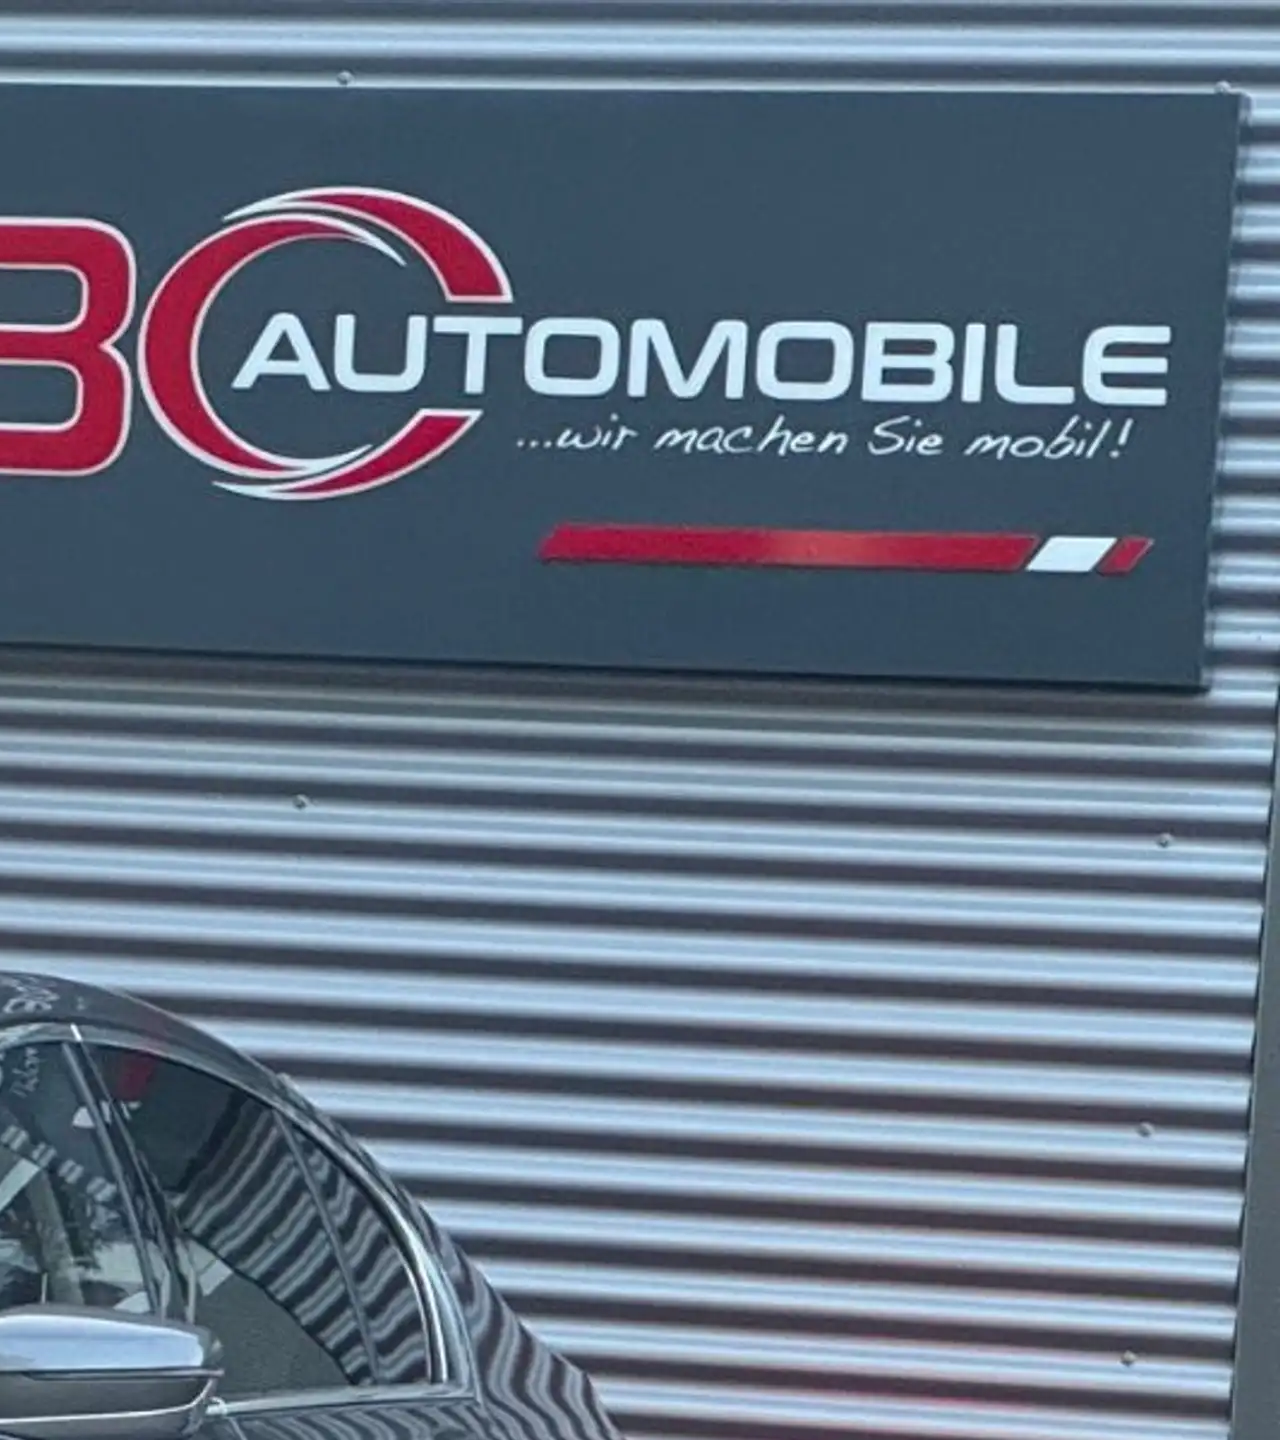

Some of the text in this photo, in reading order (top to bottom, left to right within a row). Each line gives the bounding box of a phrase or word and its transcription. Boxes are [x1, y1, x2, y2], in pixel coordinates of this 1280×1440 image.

[231, 312, 1172, 407] AUTOMOBILE
[517, 414, 1134, 461] ...wir machen Sie mobil!
